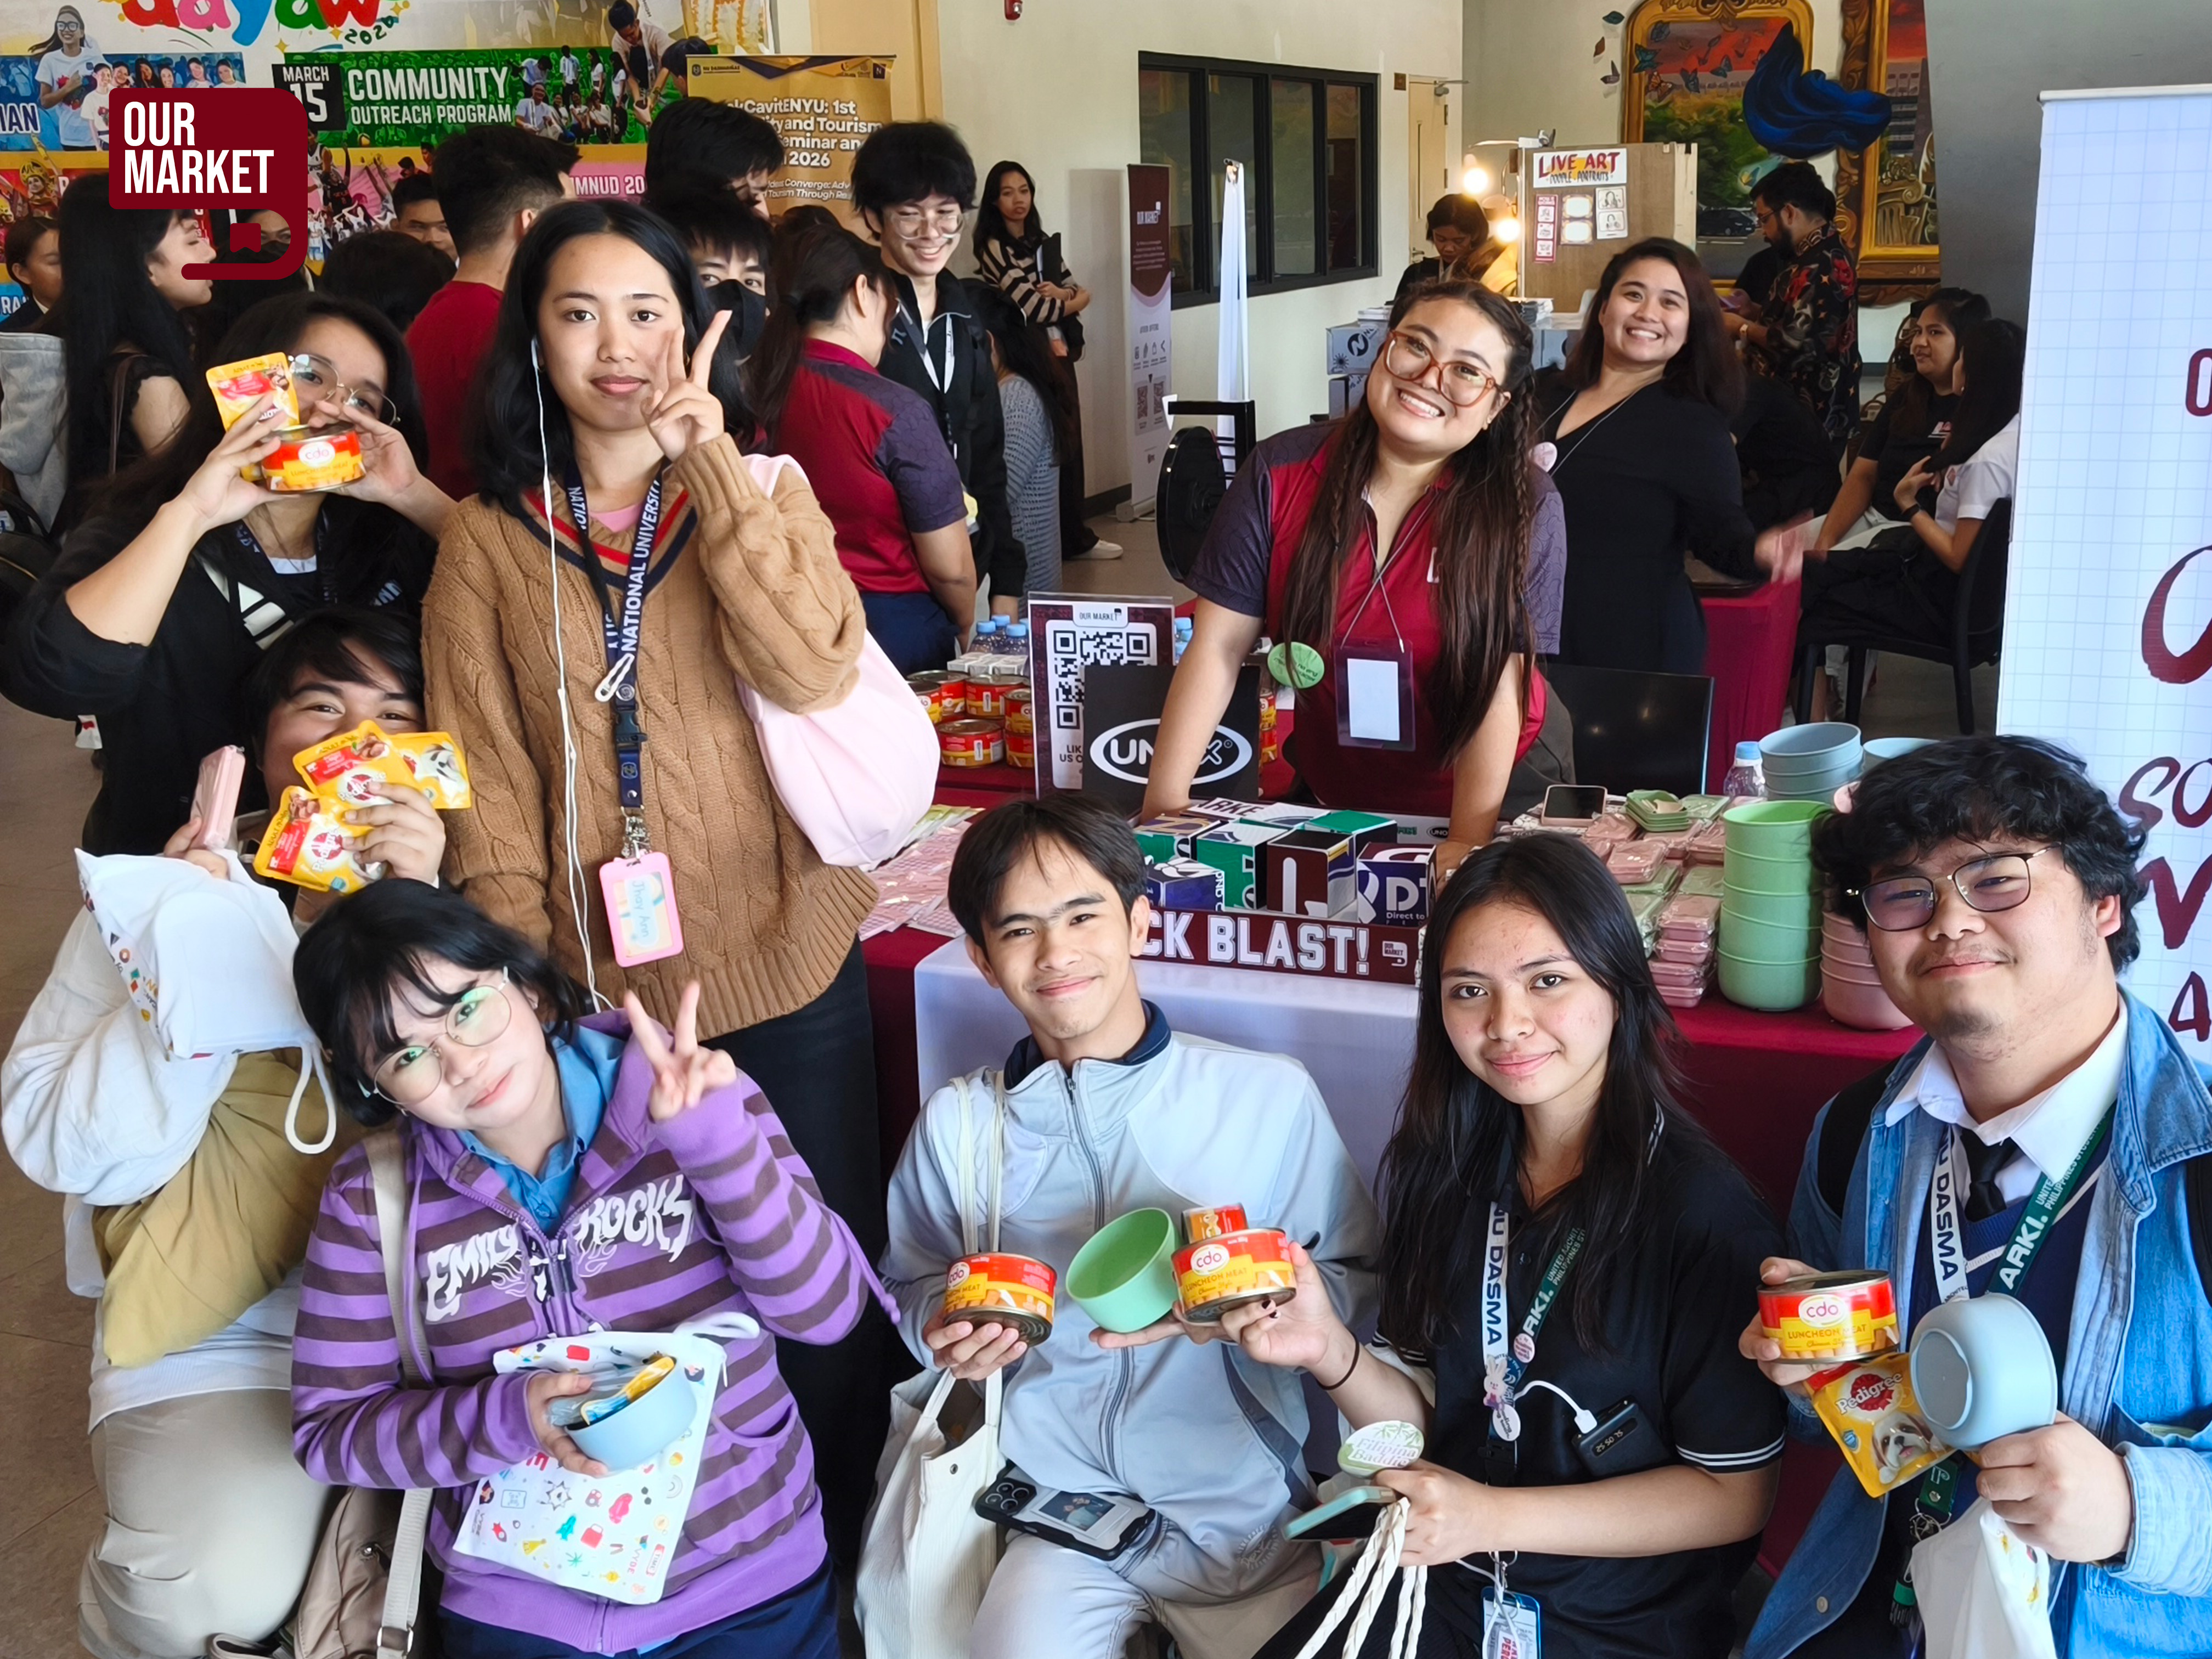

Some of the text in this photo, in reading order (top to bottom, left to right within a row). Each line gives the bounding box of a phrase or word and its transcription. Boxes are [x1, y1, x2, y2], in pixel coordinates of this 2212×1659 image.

[283, 66, 329, 82] MARCH
[347, 66, 508, 101] COMMUNITY
[351, 104, 511, 125] OUTREACH PROGRAM
[833, 99, 856, 115] 1st
[785, 117, 814, 131] and
[789, 151, 831, 167] 2026
[1539, 152, 1620, 178] LIVE ART
[796, 189, 834, 200] Through
[305, 447, 329, 460] cdo
[621, 562, 646, 652] NATIONAL
[1093, 612, 1118, 621] MARKET
[1059, 754, 1073, 763] US
[1386, 912, 1413, 920] Direct
[1207, 914, 1370, 976] BLAST!
[1936, 1172, 1958, 1281] DASMA
[425, 1174, 694, 1322] EMILY ROCKS
[1999, 1215, 2049, 1290] ARKI.
[1197, 1250, 1222, 1268] cdo
[1186, 1267, 1248, 1291] LUNCHEON MEAT
[1486, 1246, 1504, 1346] DASMA
[1806, 1301, 1838, 1318] cdo
[1788, 1329, 1838, 1339] LUNCHEON
[1836, 1373, 1903, 1415] Pedigree
[1352, 1448, 1407, 1467] Baddie
[1356, 1438, 1416, 1458] Filipina
